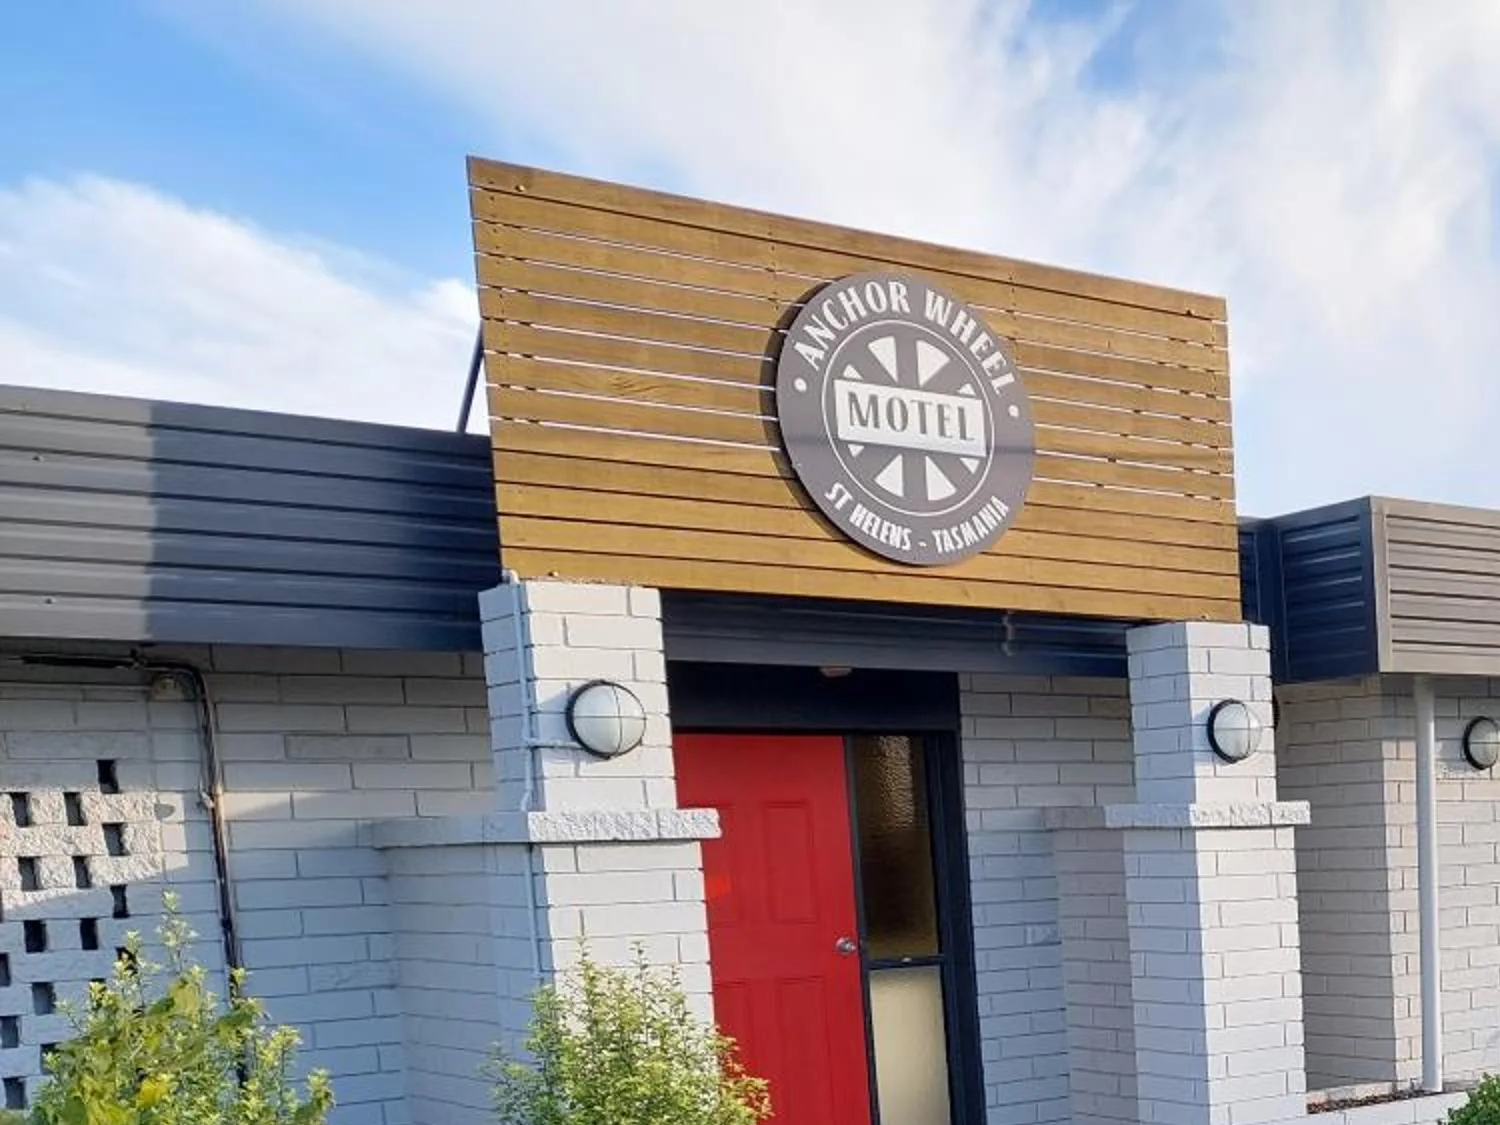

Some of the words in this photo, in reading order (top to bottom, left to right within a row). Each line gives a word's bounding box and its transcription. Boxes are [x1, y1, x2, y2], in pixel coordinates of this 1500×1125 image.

[794, 281, 910, 371] ANCHOR
[924, 288, 1016, 395] WHEEL
[848, 391, 976, 442] MOTEL
[823, 482, 853, 510] ST
[848, 504, 913, 552] HELENS
[931, 495, 1009, 554] TASMANIA
